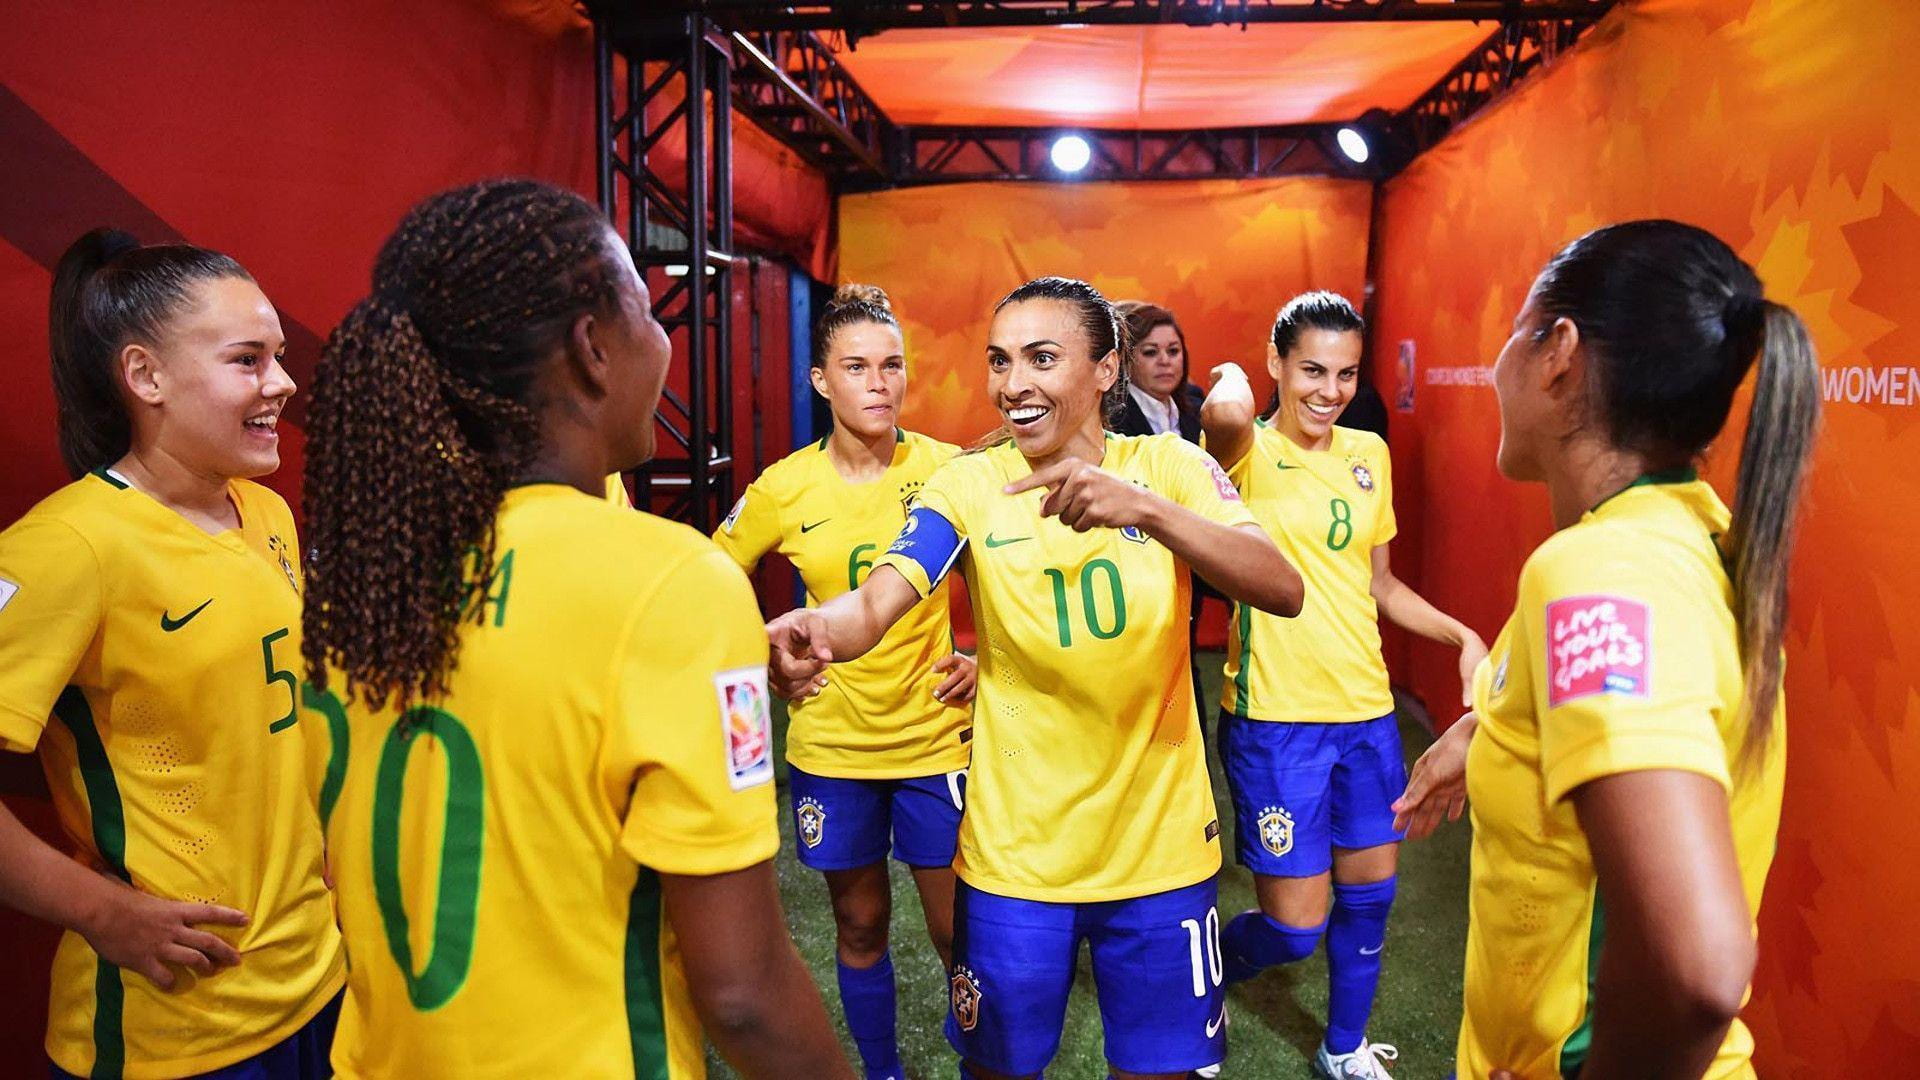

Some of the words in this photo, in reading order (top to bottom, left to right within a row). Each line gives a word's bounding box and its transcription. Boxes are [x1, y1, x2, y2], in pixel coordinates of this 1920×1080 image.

[1327, 498, 1352, 551] 8
[1043, 558, 1127, 648] 10
[1554, 622, 1636, 666] YOUR
[1554, 641, 1644, 691] GOALS
[262, 627, 298, 734] 5
[1181, 906, 1223, 997] 10
